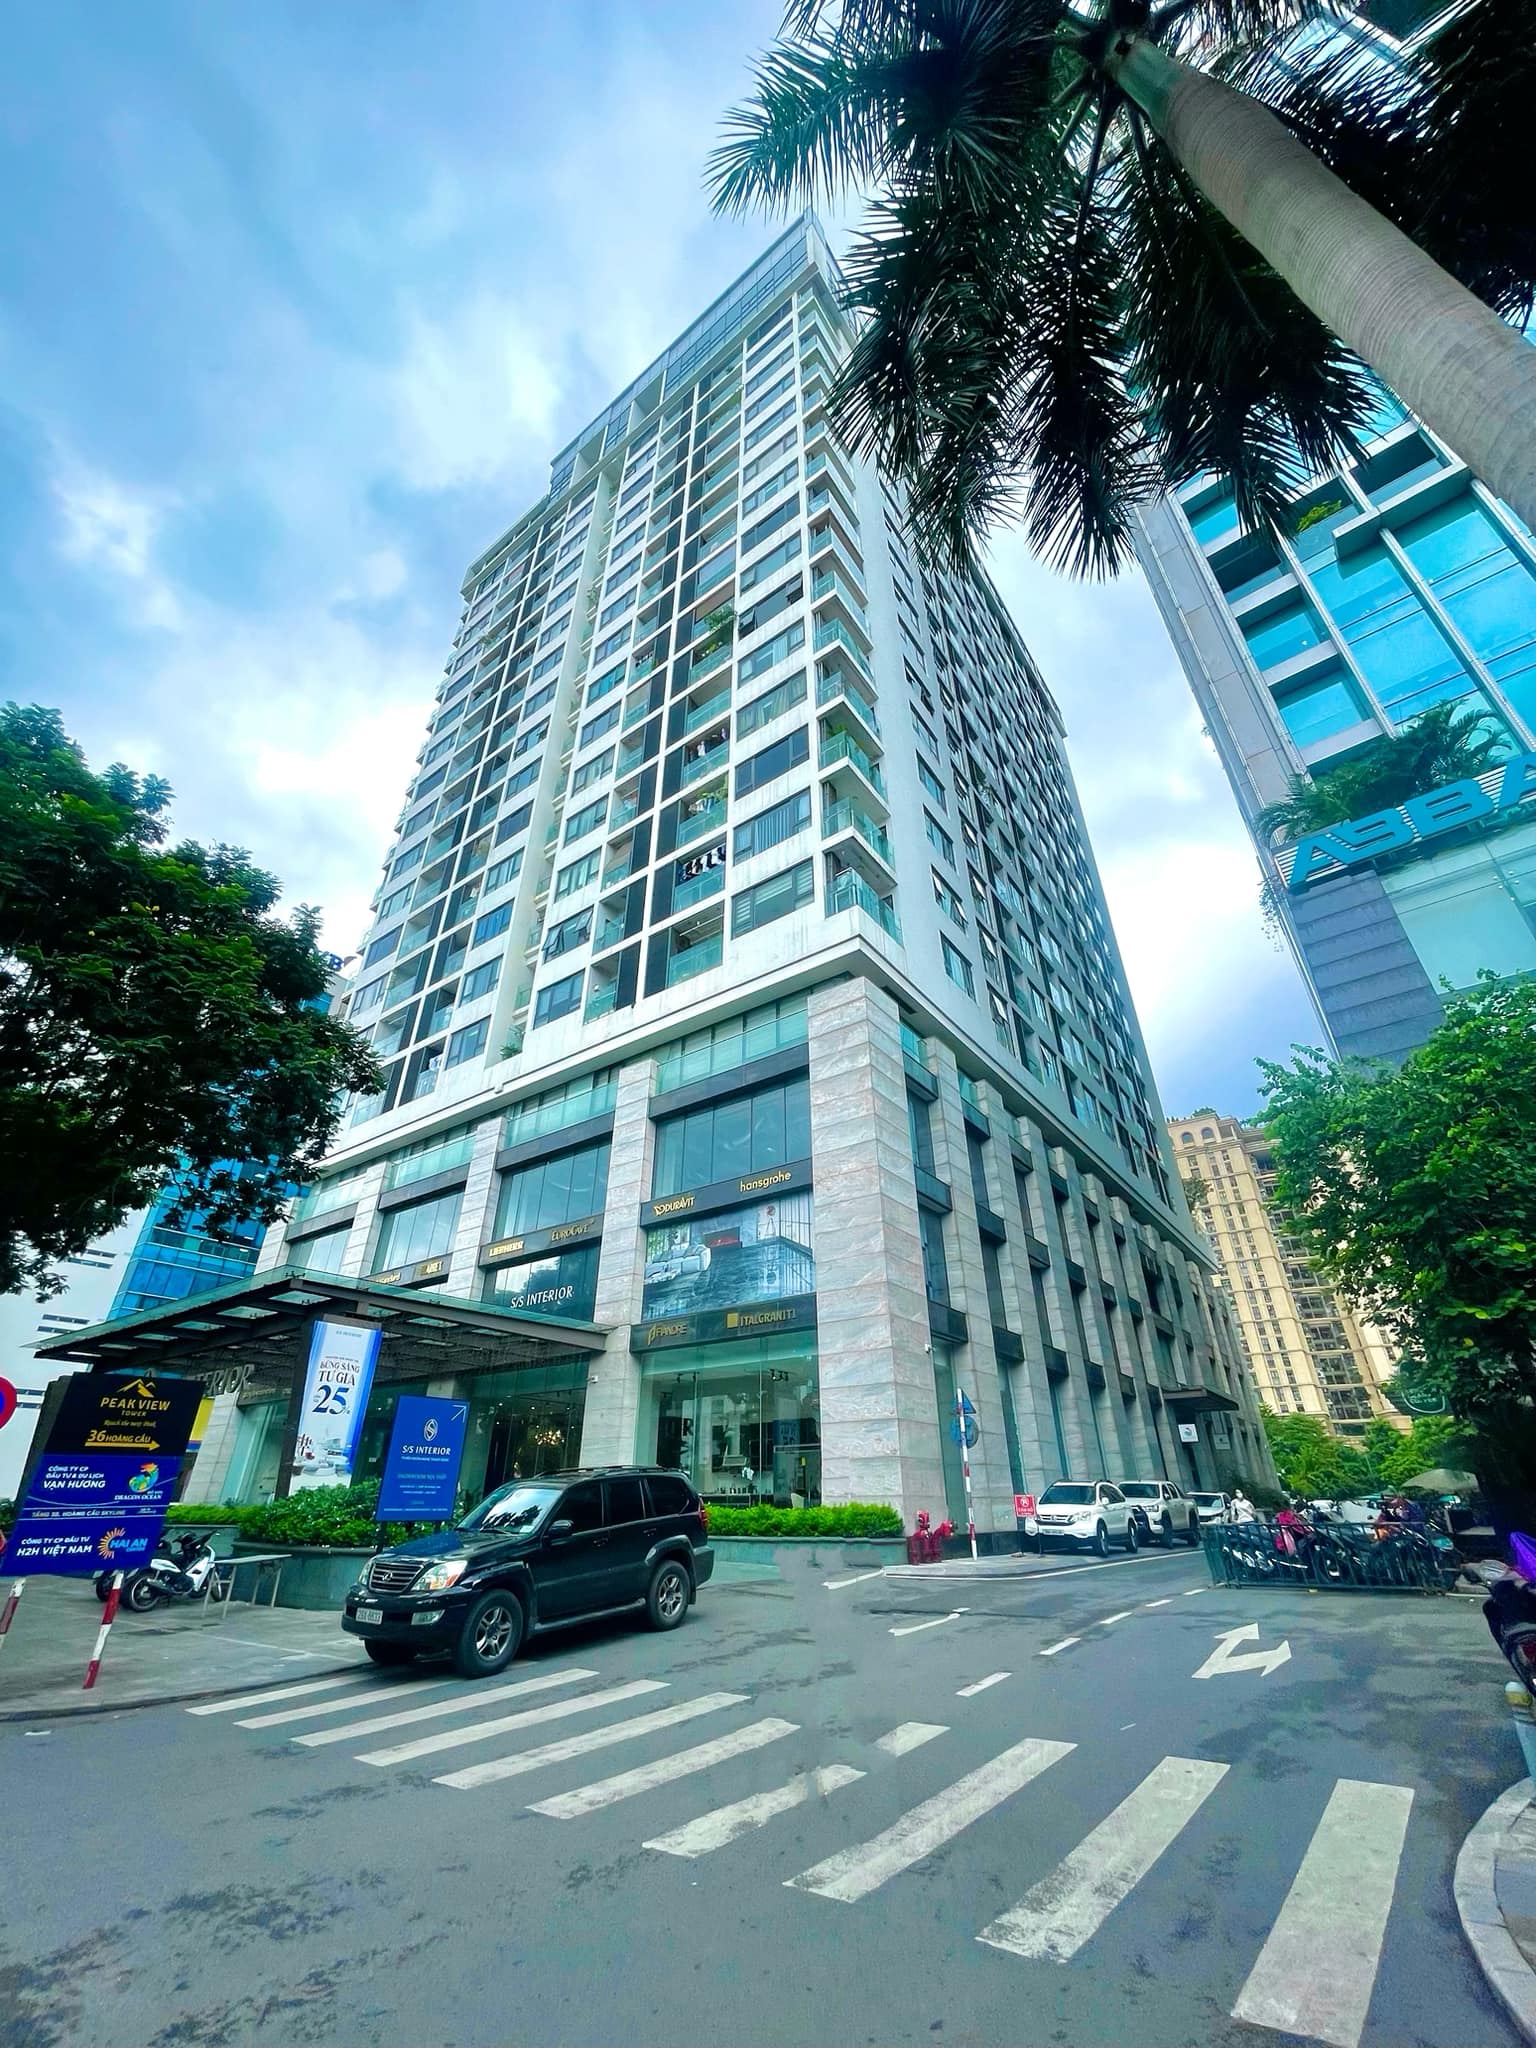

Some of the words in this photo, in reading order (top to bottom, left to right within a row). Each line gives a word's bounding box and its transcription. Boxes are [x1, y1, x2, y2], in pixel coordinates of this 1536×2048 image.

[739, 1170, 792, 1193] hansgrohe
[663, 1197, 696, 1214] DURAVIT
[489, 1240, 524, 1257] LIEBHERR
[526, 1285, 573, 1306] INTERIOR
[740, 1308, 796, 1327] ITALGRANITI
[656, 1323, 688, 1337] FIANDRE
[100, 1397, 136, 1409] PEAK
[138, 1400, 171, 1411] VIEW
[88, 1429, 106, 1442] 36
[415, 1446, 451, 1455] INTERIOR
[43, 1480, 66, 1491] VẠN
[67, 1479, 106, 1489] HƯƠNG
[21, 1537, 42, 1545] CÔNG
[131, 1538, 148, 1548] AN
[17, 1547, 40, 1557] H2H
[42, 1544, 67, 1557] VIỆT
[67, 1545, 93, 1554] NAM
